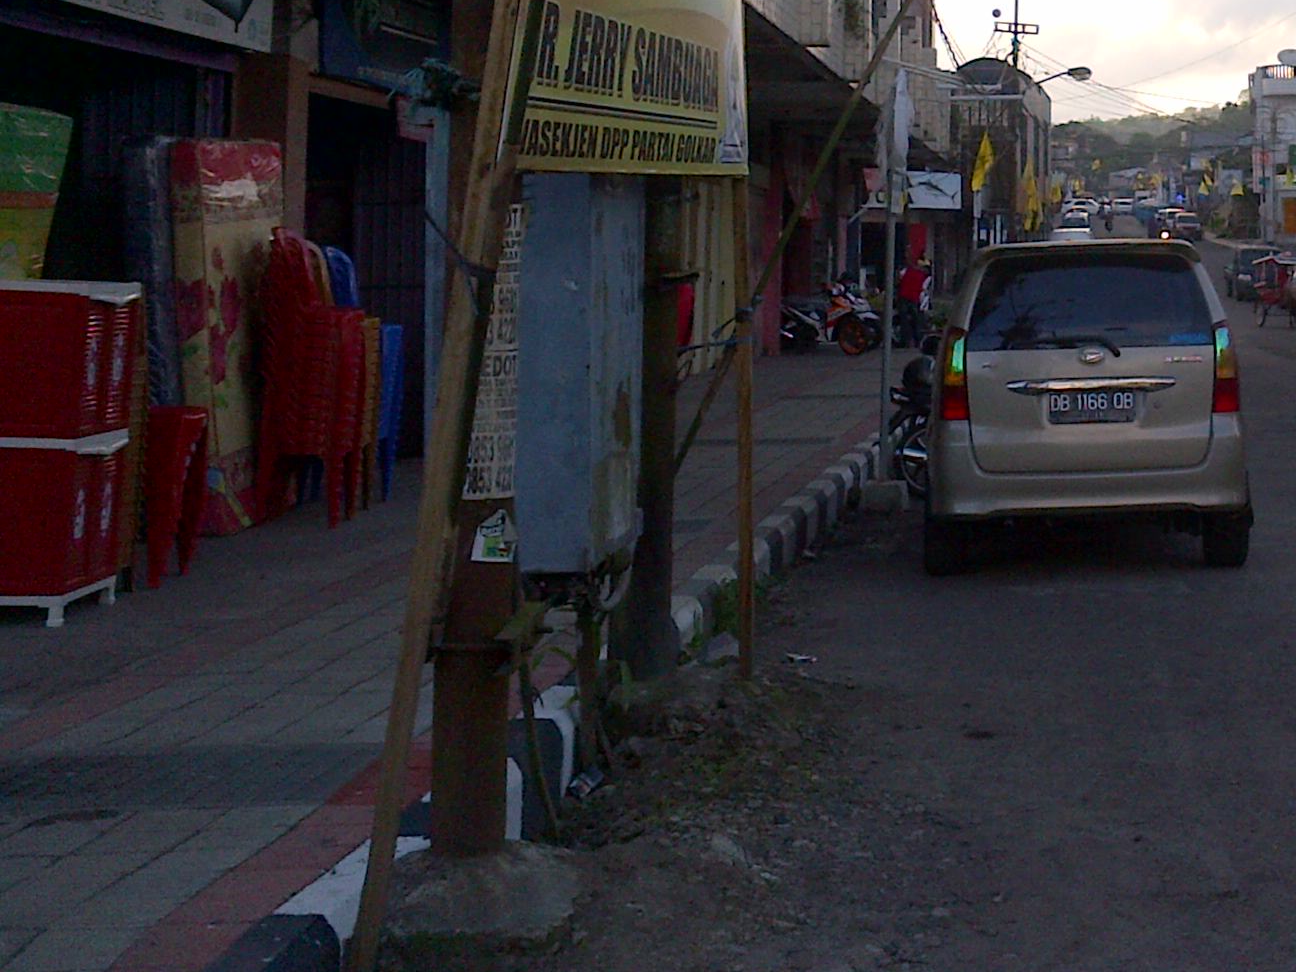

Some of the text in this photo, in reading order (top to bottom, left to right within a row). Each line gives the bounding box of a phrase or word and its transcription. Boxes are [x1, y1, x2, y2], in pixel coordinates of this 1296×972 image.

[565, 9, 632, 94] JERRY
[600, 126, 630, 161] DPP
[630, 129, 676, 163] PARTAI
[676, 132, 717, 164] GOLKAR
[1051, 394, 1070, 411] DB
[1077, 393, 1108, 410] 1166
